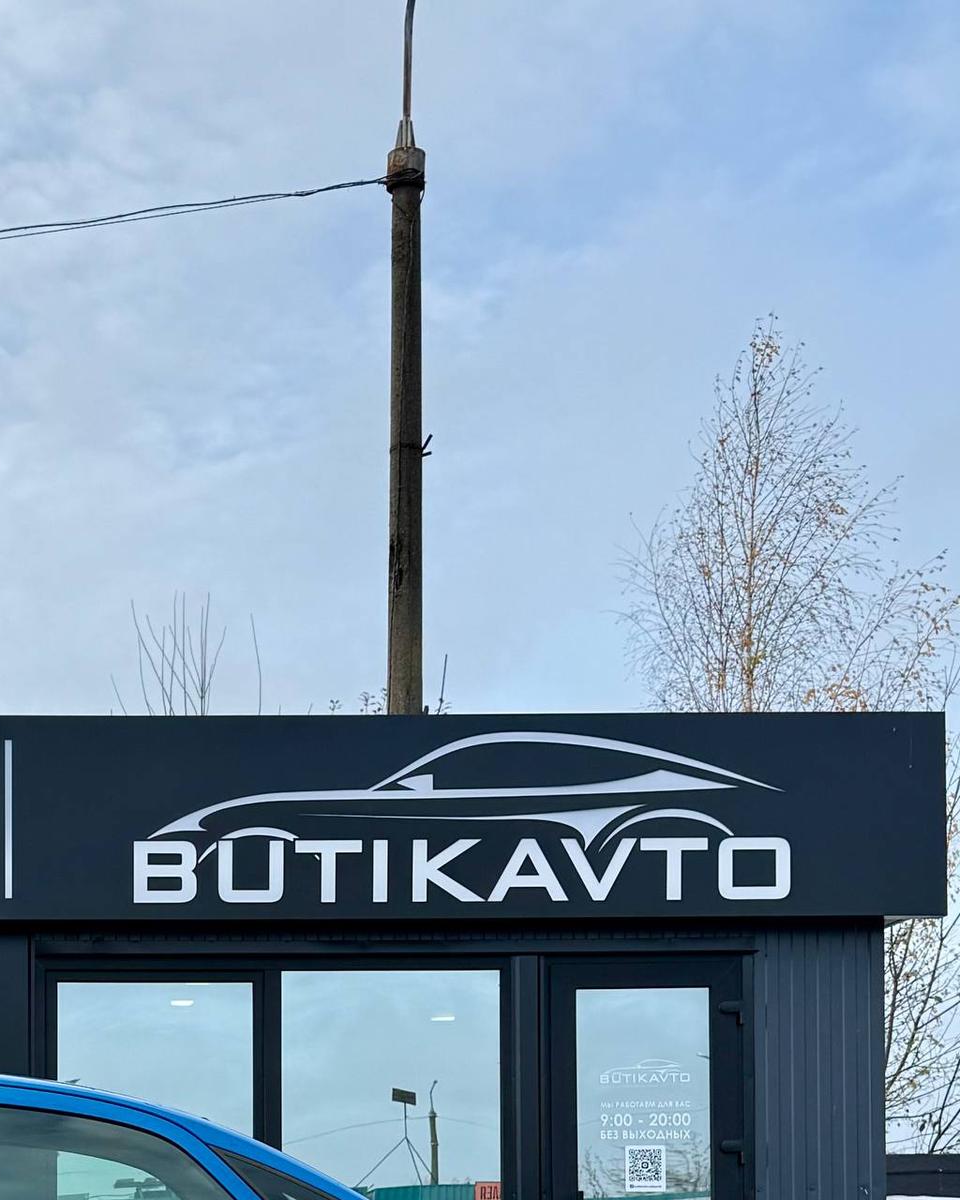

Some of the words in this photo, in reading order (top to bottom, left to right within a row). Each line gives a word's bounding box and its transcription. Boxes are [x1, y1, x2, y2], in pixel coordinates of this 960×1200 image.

[133, 836, 792, 904] BUTIKAVTO
[599, 1072, 691, 1084] BUTIKAVTO
[615, 1101, 655, 1109] РАБОТАЕМ
[675, 1100, 691, 1108] ВАС
[600, 1113, 632, 1126] 9:00
[649, 1112, 691, 1126] 20:00
[600, 1130, 619, 1140] БЕЗ
[622, 1129, 691, 1140] ВЫХОДНЫХ
